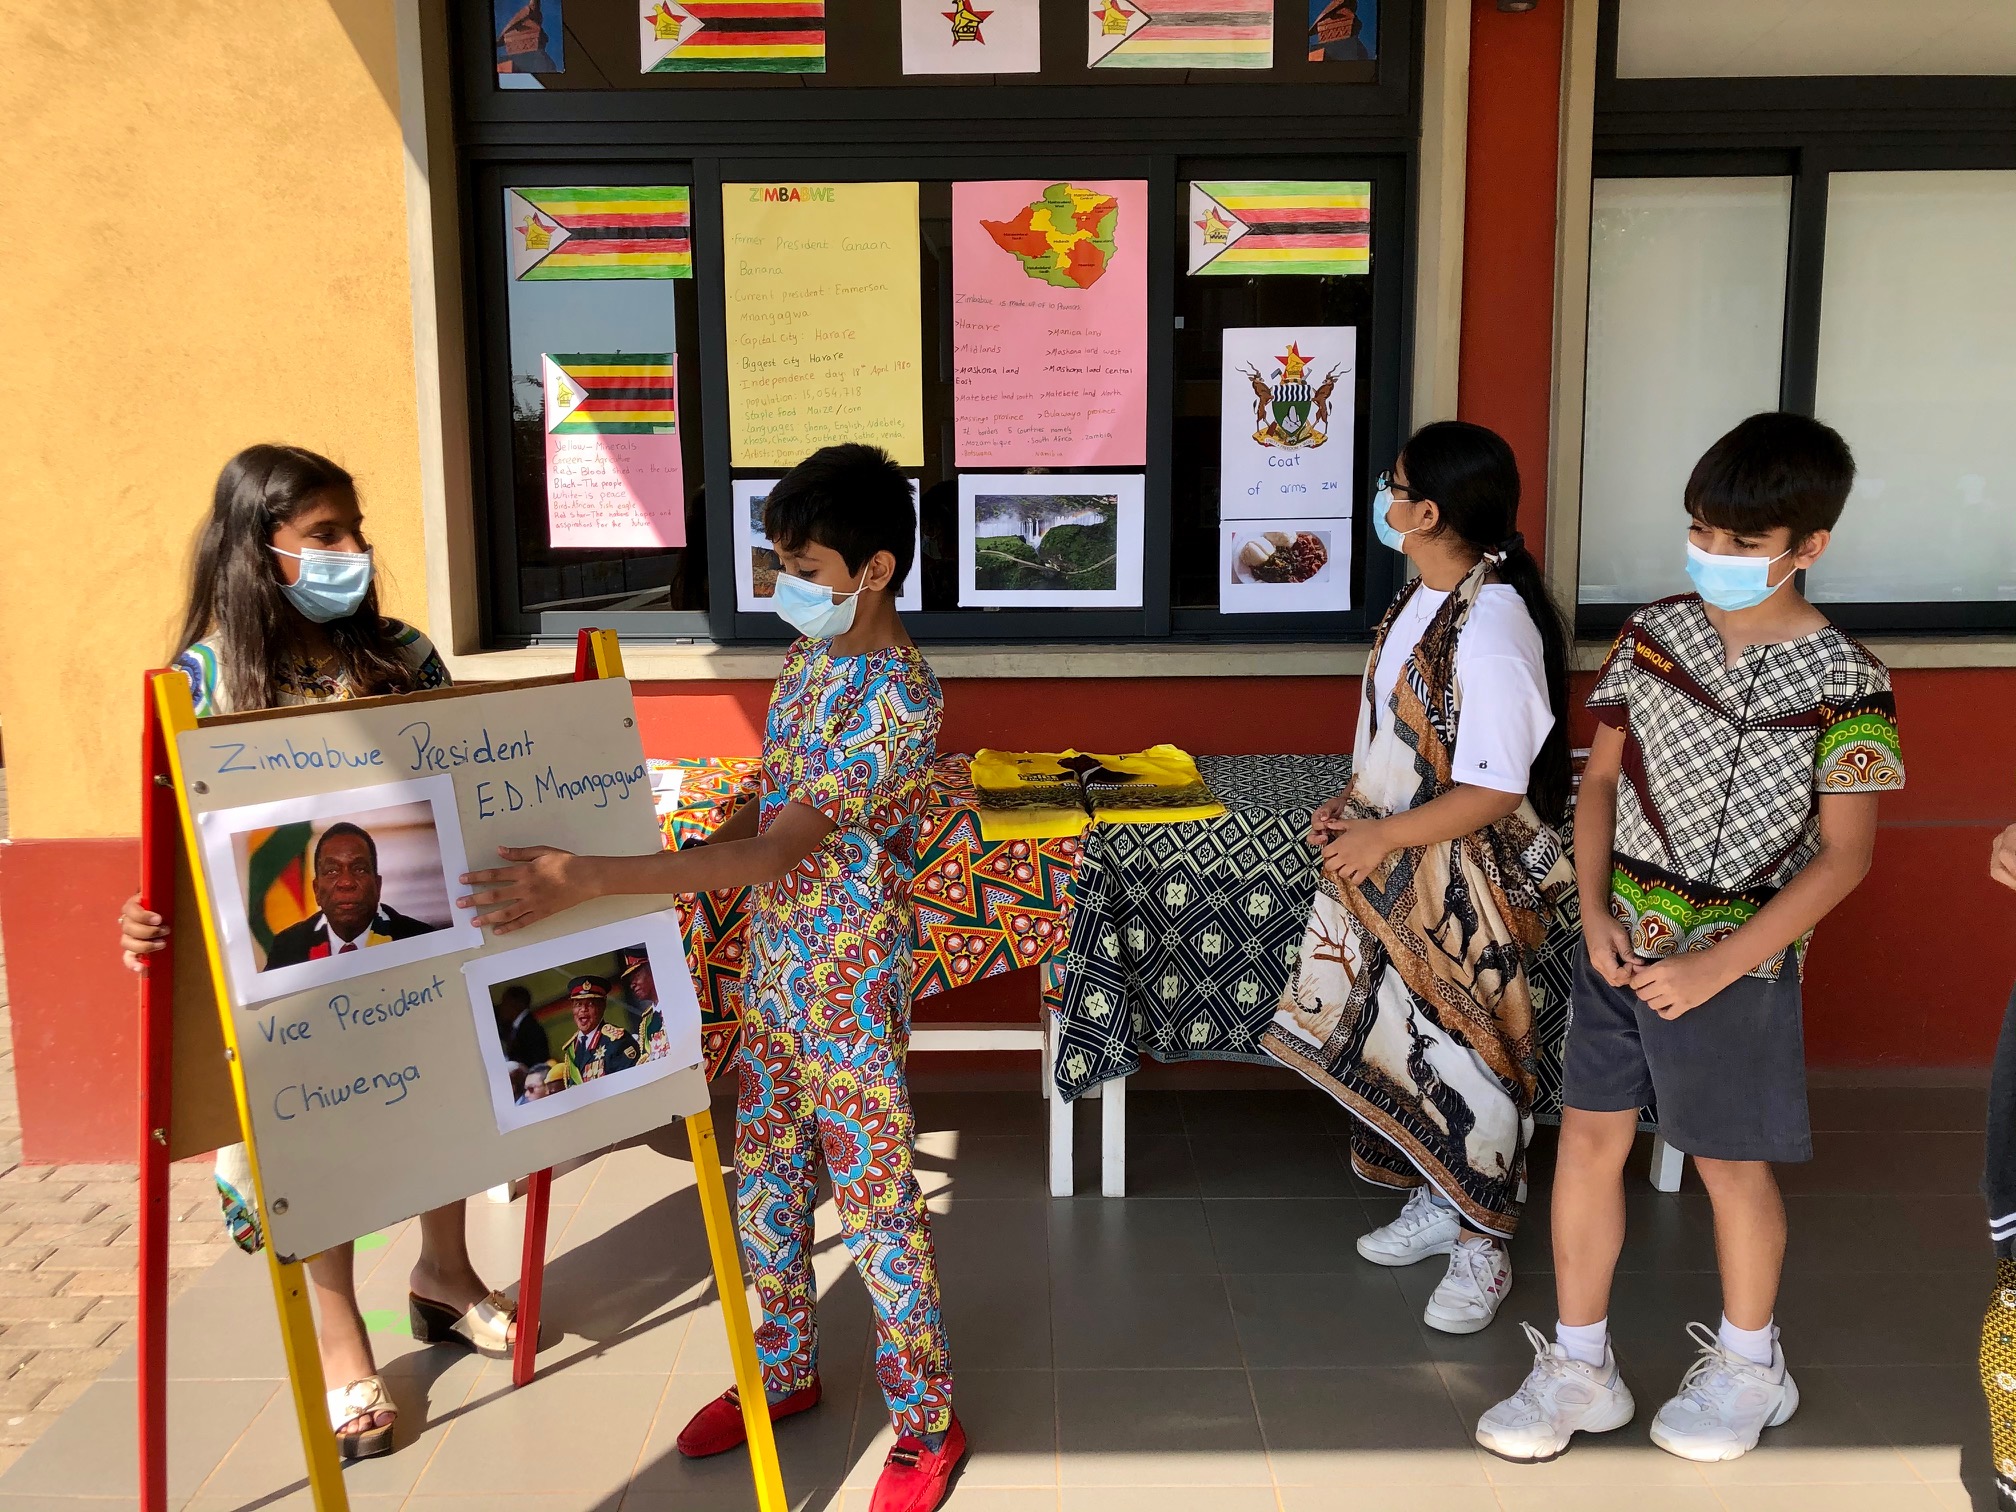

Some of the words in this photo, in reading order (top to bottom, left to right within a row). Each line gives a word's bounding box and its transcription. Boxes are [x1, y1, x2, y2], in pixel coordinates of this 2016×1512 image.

[750, 187, 835, 202] ZIMBABWE
[777, 237, 829, 250] President
[842, 237, 891, 251] Canaan
[740, 261, 783, 276] Banana
[735, 289, 774, 302] Current
[835, 284, 888, 295] Emmerson
[955, 294, 993, 304] Zimbabwe
[741, 334, 776, 348] Capital
[815, 329, 856, 341] Harare
[742, 356, 776, 372] Biggest
[810, 352, 844, 363] Harare
[742, 372, 815, 389] Independence
[871, 366, 888, 376] April
[894, 361, 911, 372] 1980
[994, 414, 1024, 422] province
[805, 433, 848, 443] Southern
[1031, 436, 1049, 444] South
[596, 441, 637, 451] Minerals
[1268, 454, 1300, 467] Coat
[602, 479, 622, 488] people
[1248, 481, 1262, 495] of
[1280, 484, 1306, 493] arms
[600, 491, 626, 502] peace
[618, 502, 636, 510] eagle
[1636, 642, 1674, 673] MBIQUE
[210, 737, 384, 774] Zimbabwe
[398, 721, 535, 772] President
[537, 764, 648, 808] Mnangagwa
[258, 1015, 312, 1045] Vice
[329, 975, 445, 1031] President
[1089, 1077, 1100, 1085] JAVA
[273, 1065, 421, 1121] Chiwenga
